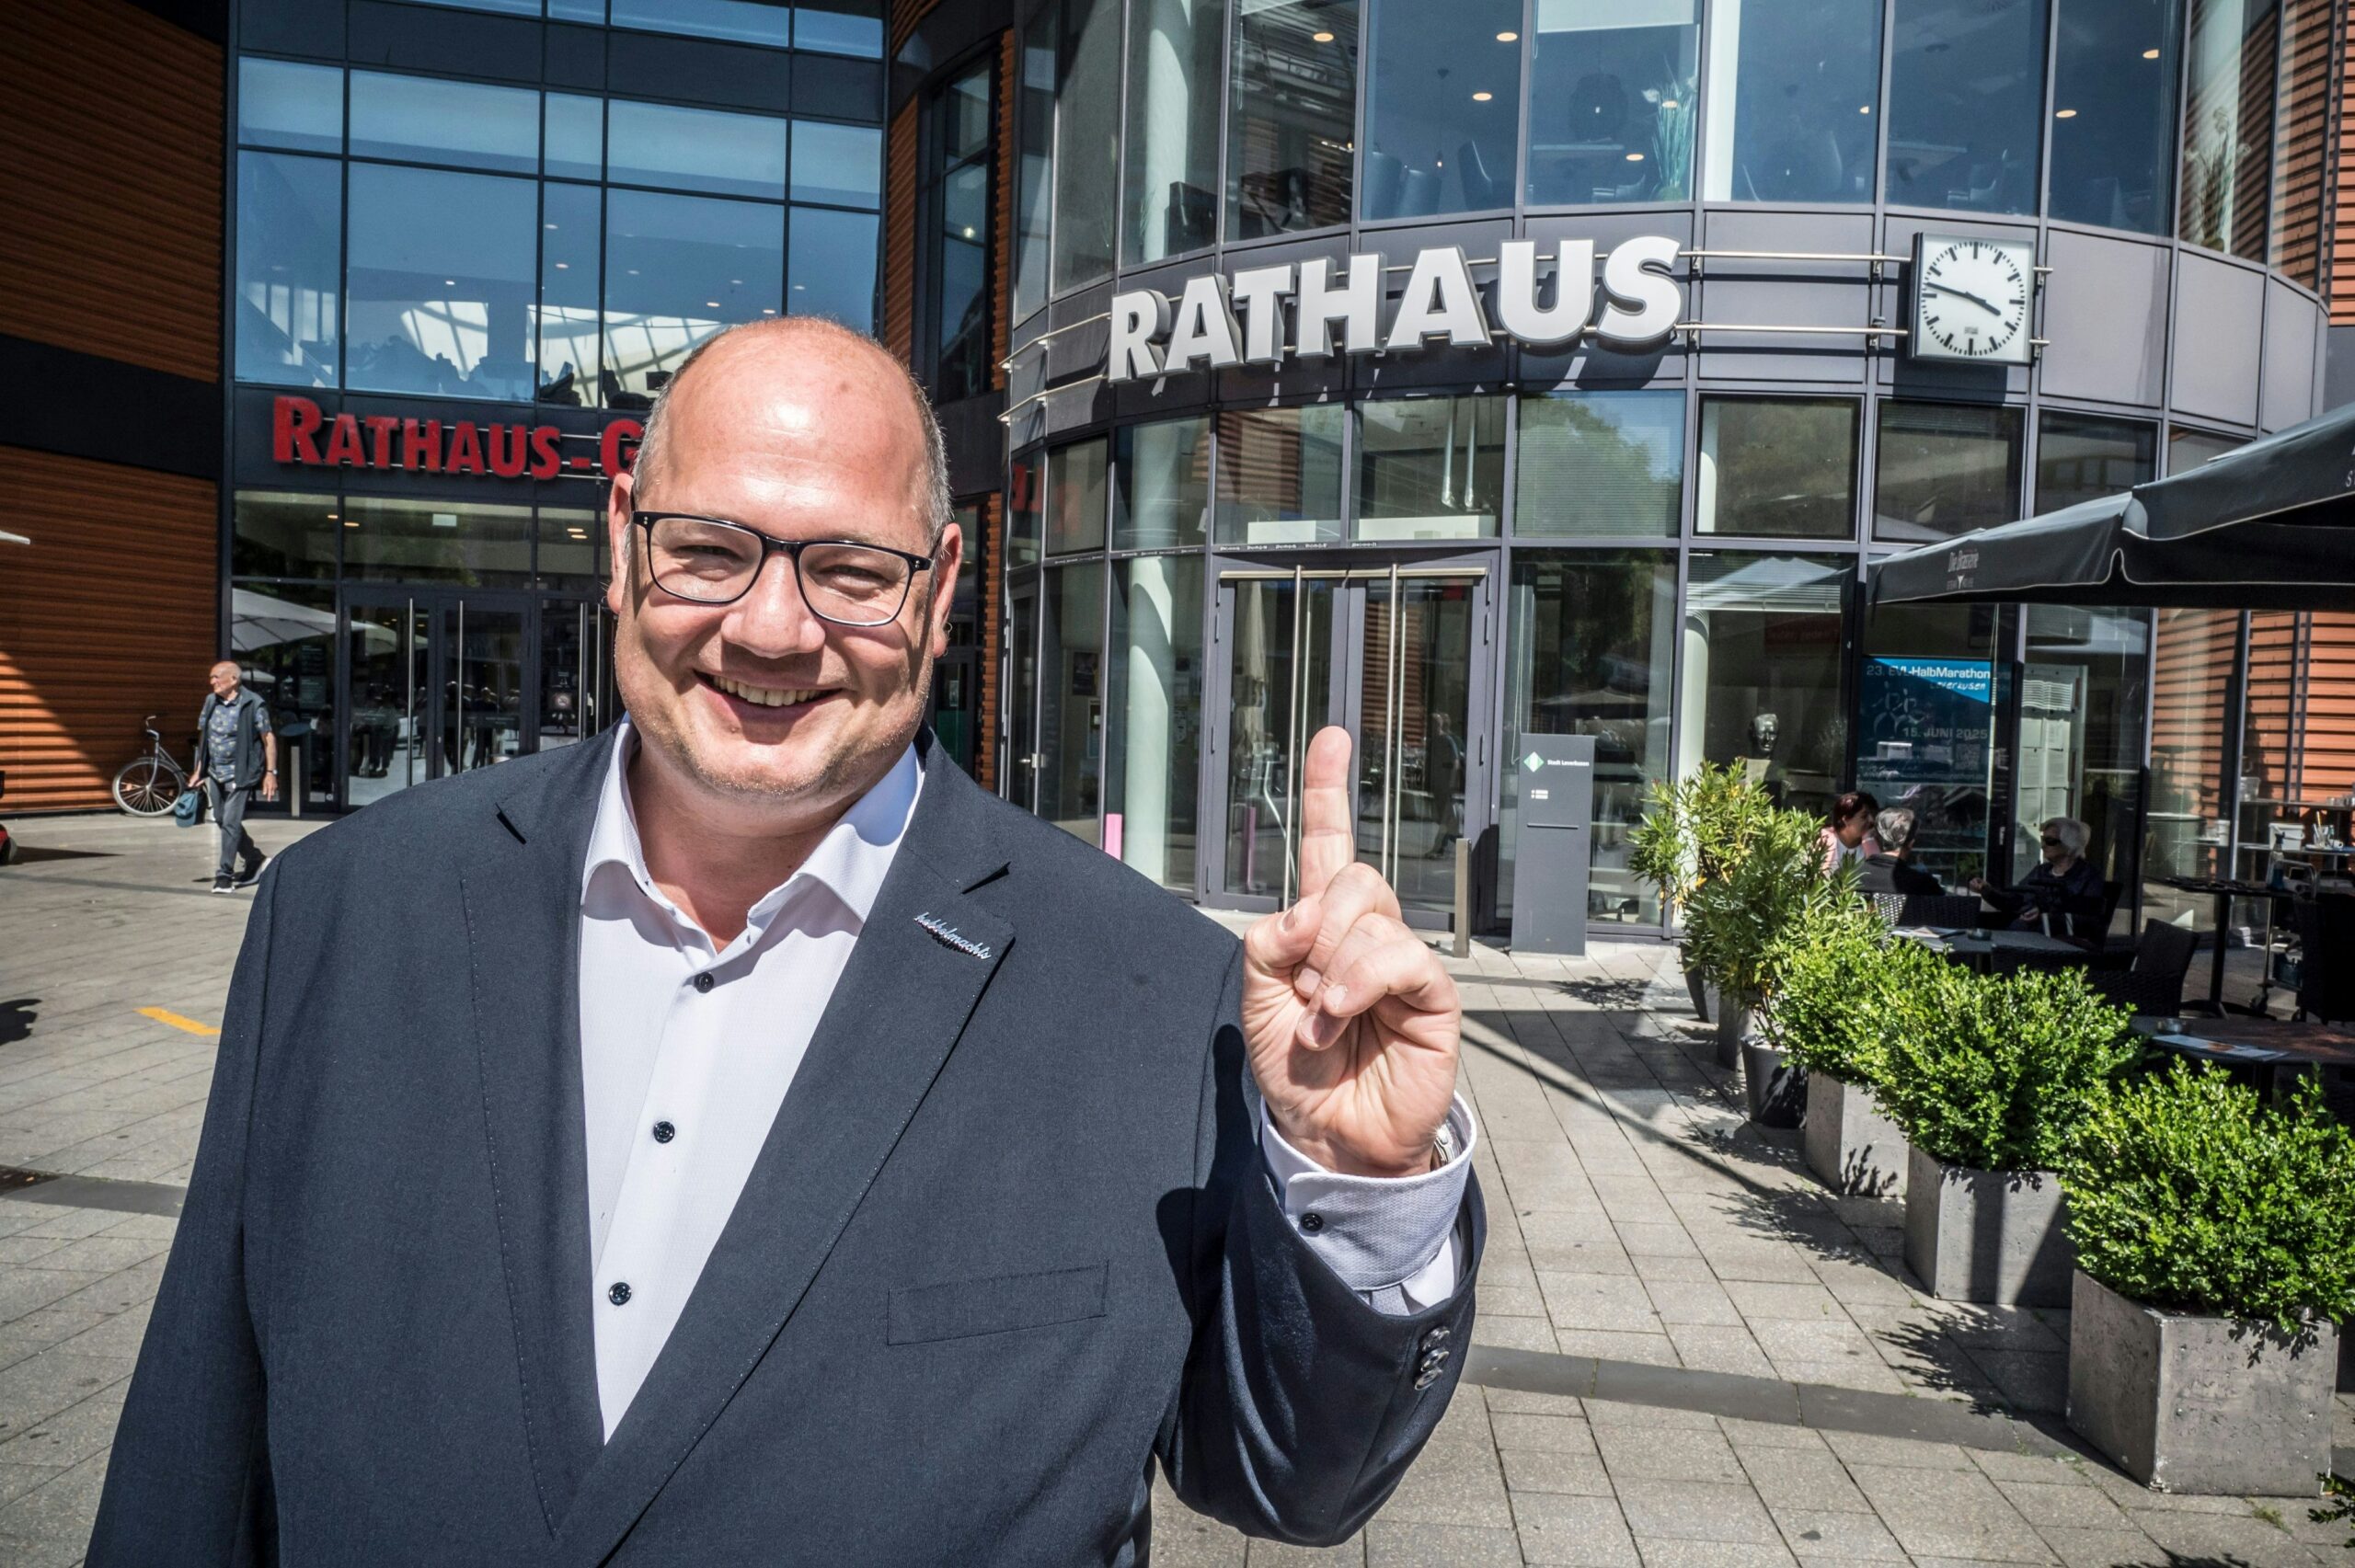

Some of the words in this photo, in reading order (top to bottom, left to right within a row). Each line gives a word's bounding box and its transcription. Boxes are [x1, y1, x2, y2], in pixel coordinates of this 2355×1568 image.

[1108, 235, 1683, 383] RATHAUS
[1867, 665, 1885, 677] 23.
[1889, 666, 1990, 680] EVL-HalbMarathon
[1924, 727, 1953, 738] JUNI
[1956, 728, 1988, 739] 2025
